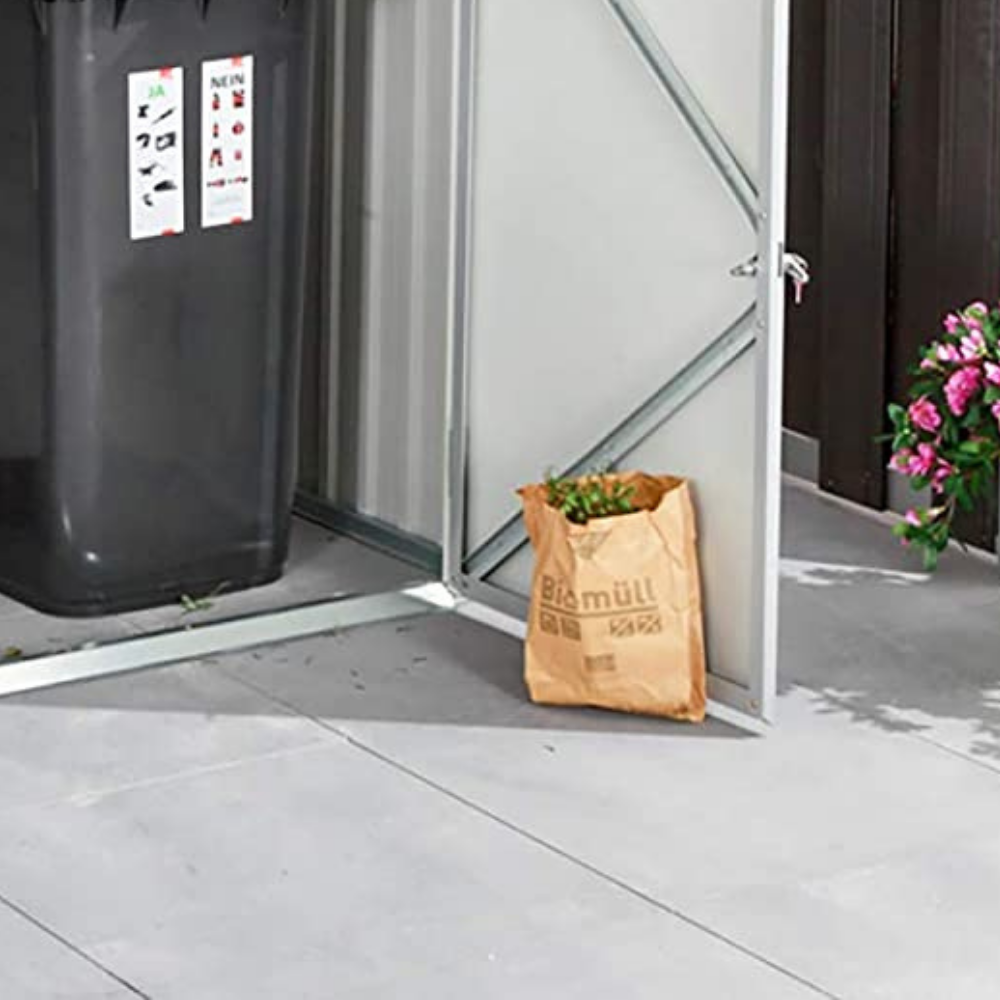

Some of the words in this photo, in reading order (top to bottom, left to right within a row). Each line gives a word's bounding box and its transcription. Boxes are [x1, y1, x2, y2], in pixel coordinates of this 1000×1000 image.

[210, 74, 245, 88] NEIN
[148, 85, 165, 98] JA
[541, 575, 657, 609] Biomüll
